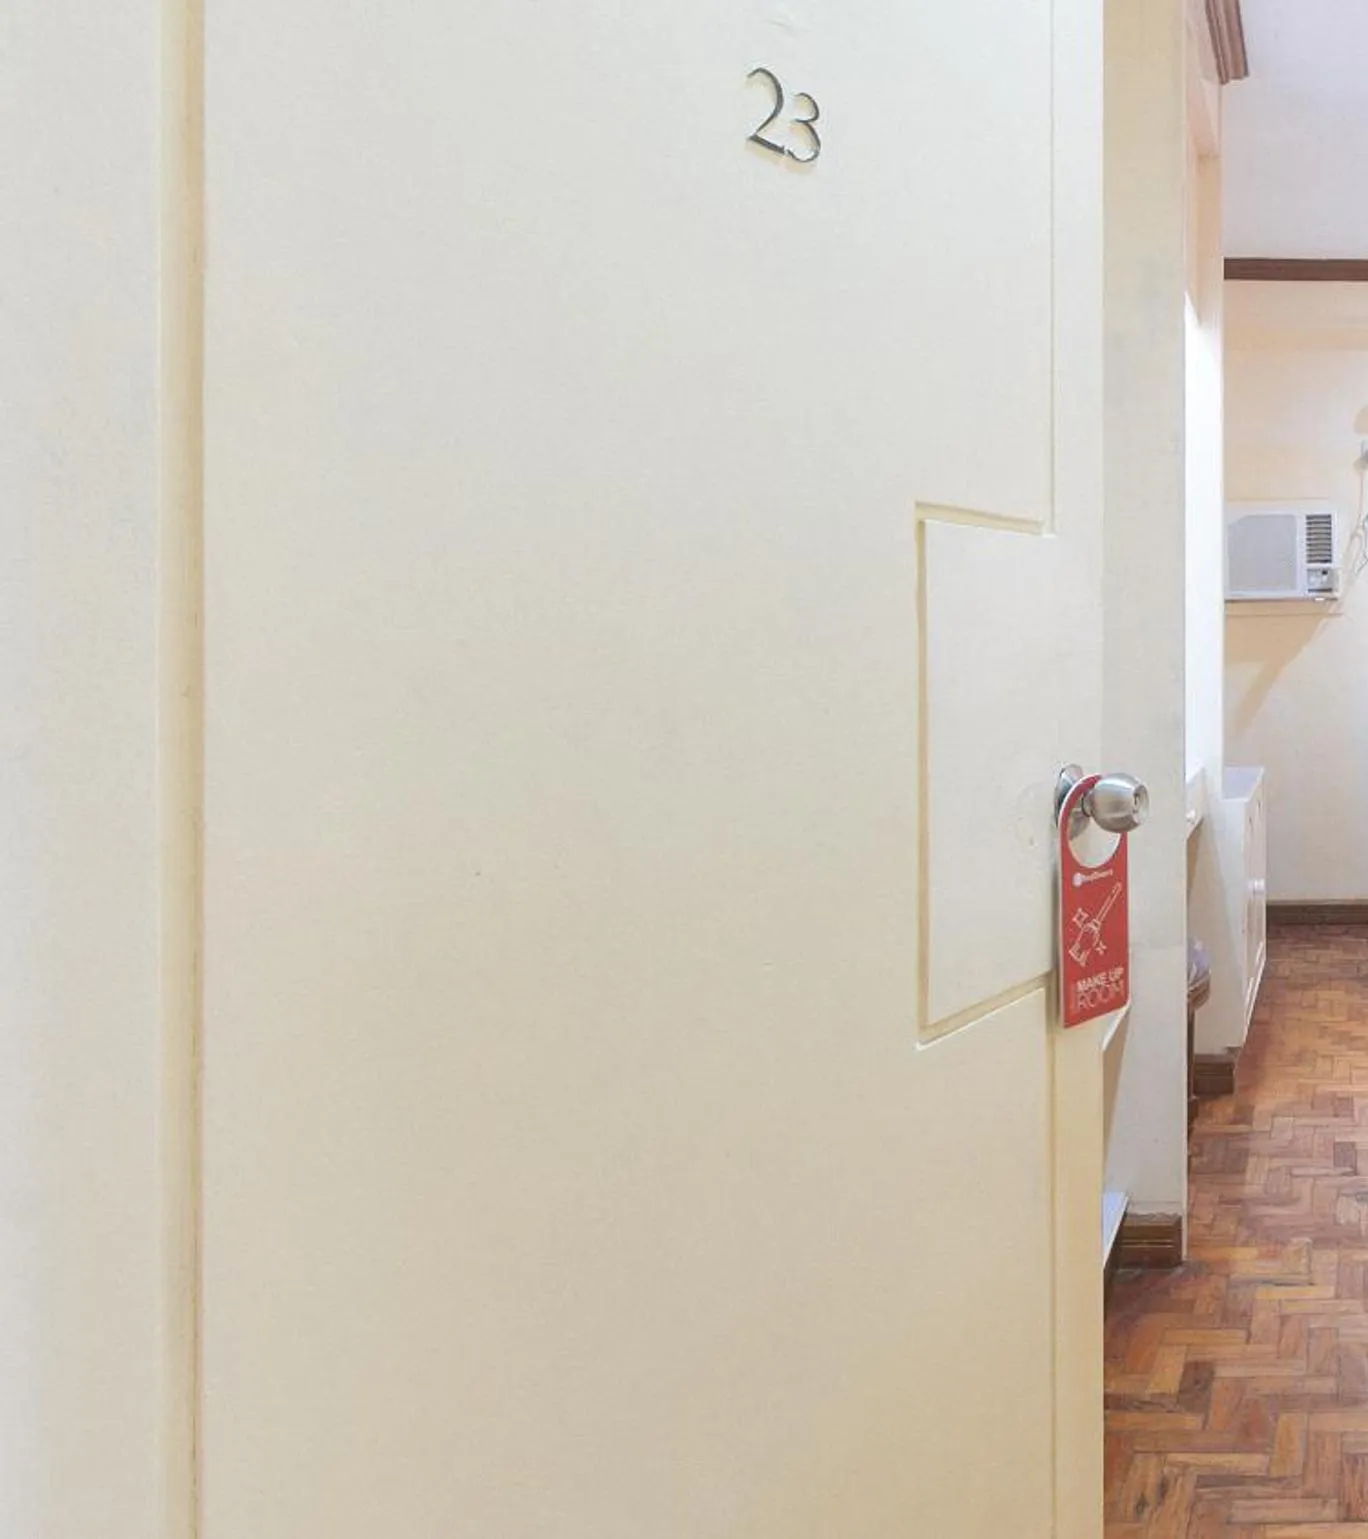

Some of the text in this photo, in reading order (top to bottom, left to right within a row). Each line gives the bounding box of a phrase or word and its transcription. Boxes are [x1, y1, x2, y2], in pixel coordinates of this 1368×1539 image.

[747, 67, 821, 163] 23
[1077, 967, 1124, 992] MAKE UP
[1077, 979, 1124, 1011] ROOM
